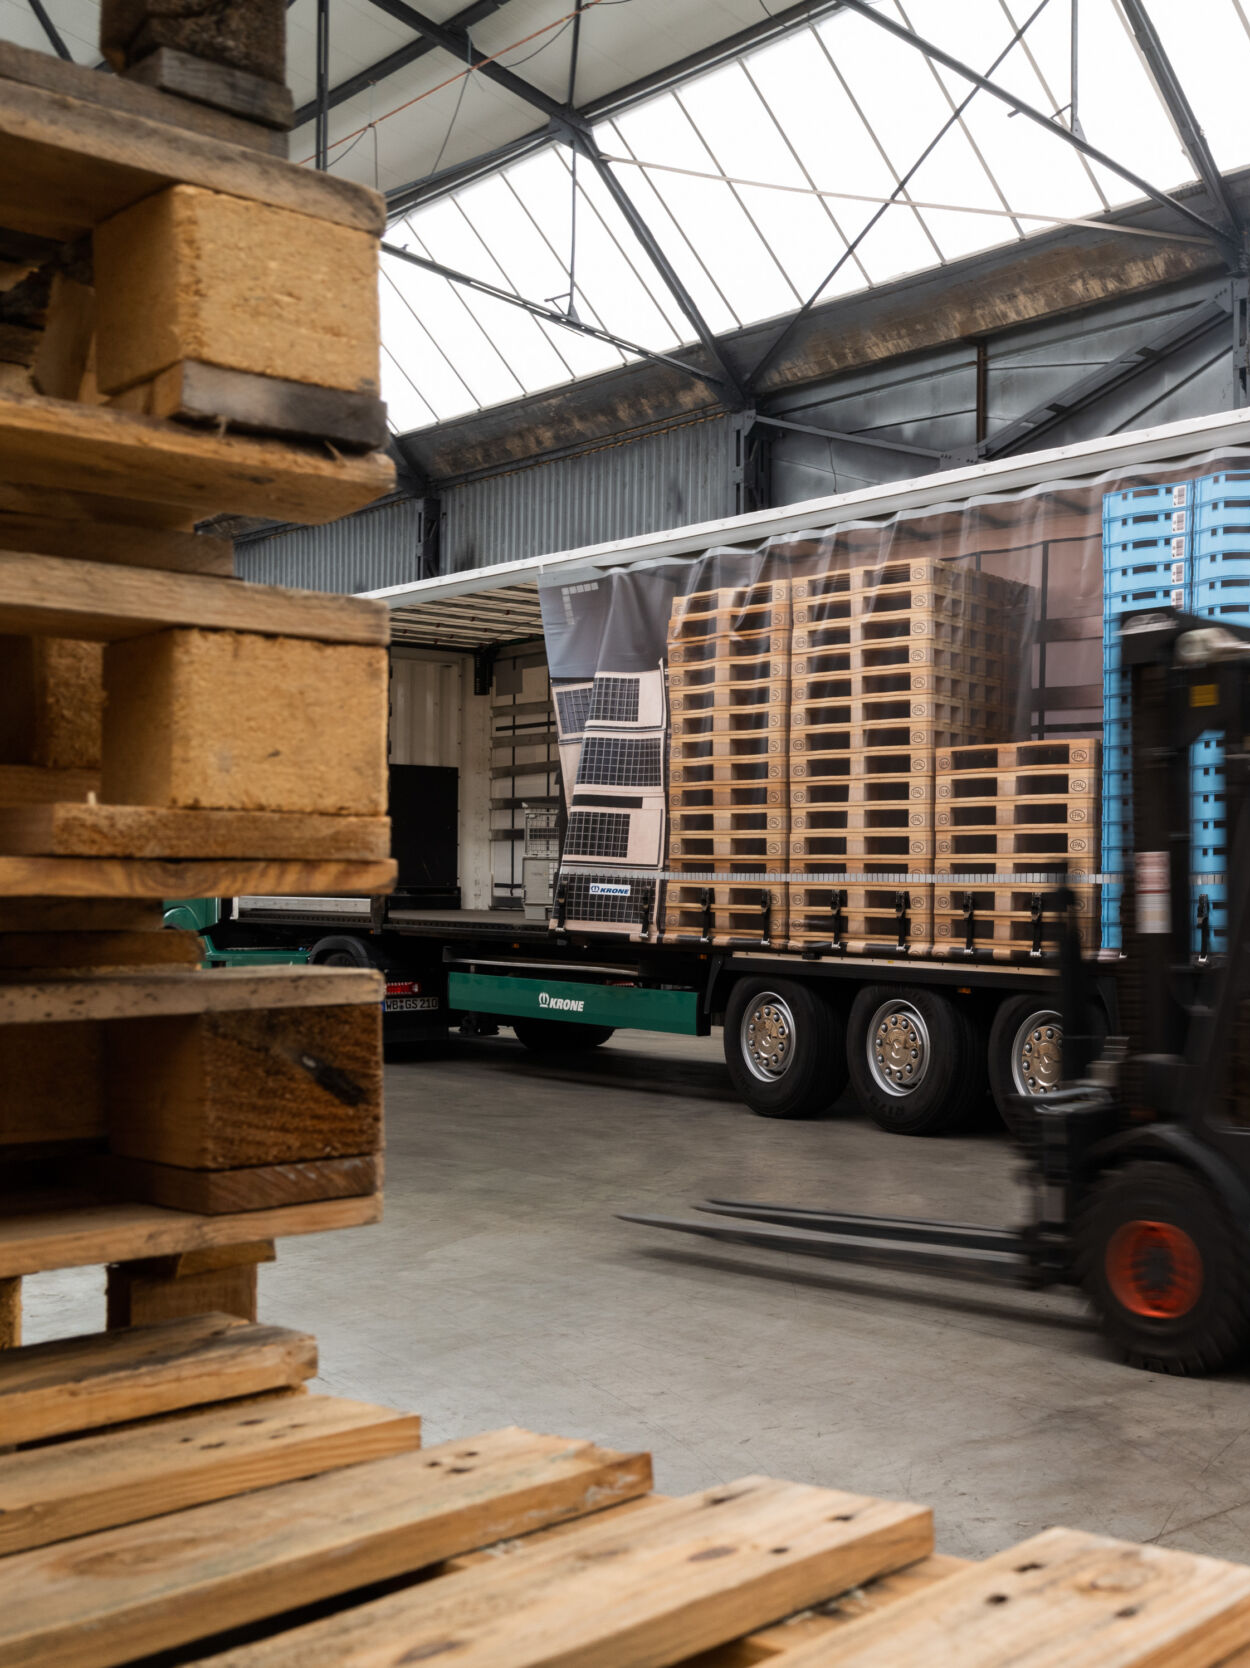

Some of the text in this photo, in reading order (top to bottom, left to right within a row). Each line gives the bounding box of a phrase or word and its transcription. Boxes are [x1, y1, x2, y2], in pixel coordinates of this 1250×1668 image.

[600, 887, 629, 895] KRONE
[420, 999, 438, 1008] 210
[550, 998, 584, 1011] KRONE
